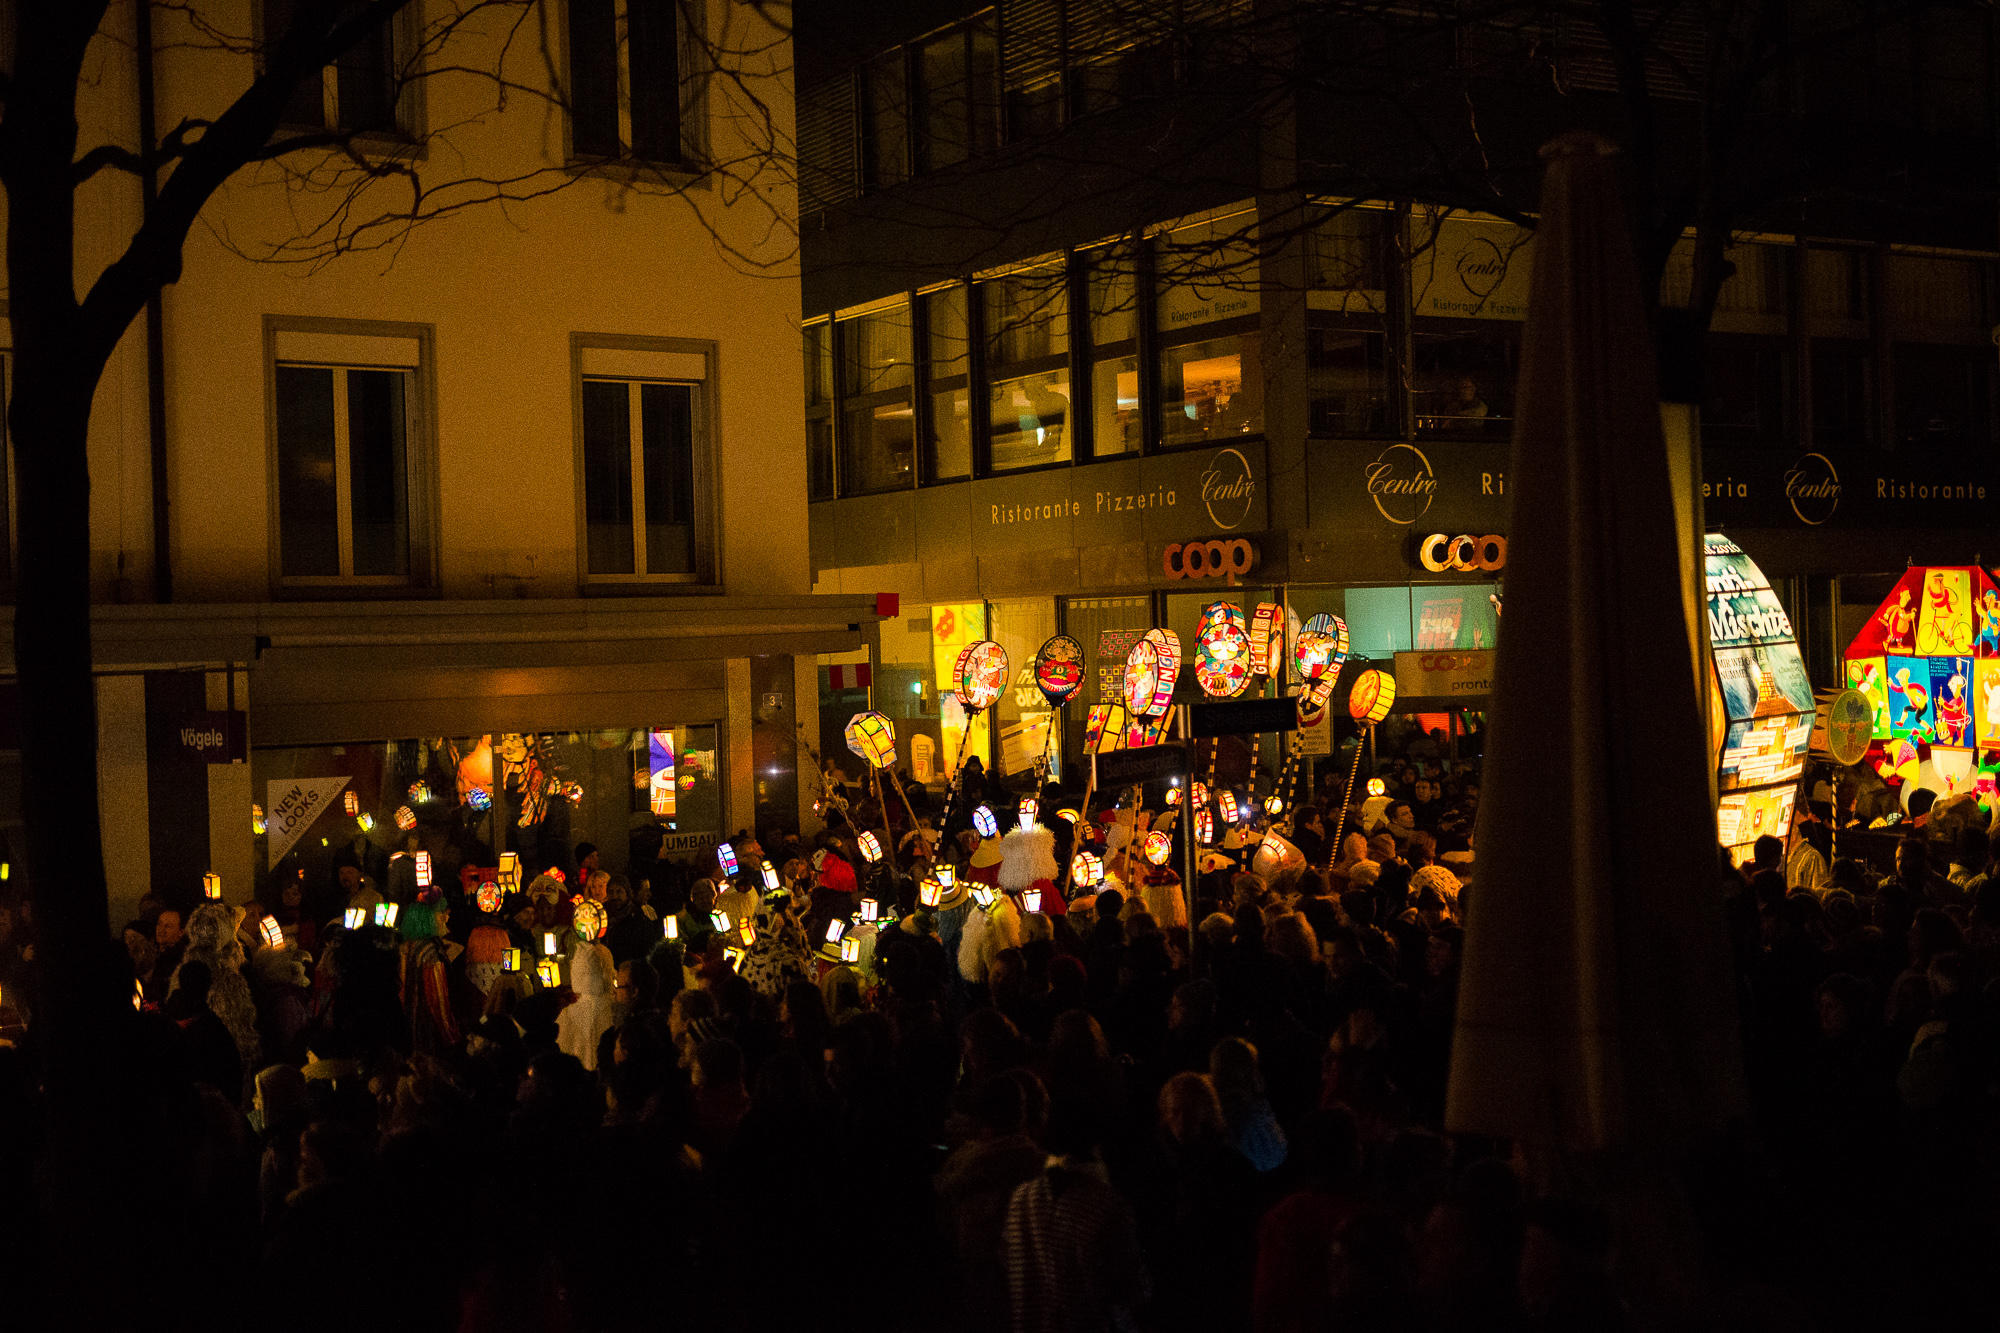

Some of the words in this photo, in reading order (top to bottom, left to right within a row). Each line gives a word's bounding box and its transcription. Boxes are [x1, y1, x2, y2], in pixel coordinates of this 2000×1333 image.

[1171, 305, 1210, 322] Ristorante
[1214, 301, 1247, 314] Pizzeria
[1433, 298, 1484, 312] Ristorante
[1201, 470, 1256, 502] Centro
[1365, 462, 1437, 494] Centro
[1701, 477, 1748, 497] eria
[1784, 469, 1841, 499] Centro
[1876, 478, 1987, 499] Ristorante
[991, 499, 1080, 524] Ristorante
[1096, 485, 1176, 513] Pizzeria
[1164, 538, 1252, 587] coop
[1420, 534, 1507, 571] coo
[769, 695, 776, 706] 3
[181, 728, 223, 750] Vögele
[273, 785, 303, 818] NEW
[278, 789, 319, 835] LOOKS
[666, 834, 717, 850] UMBAU
